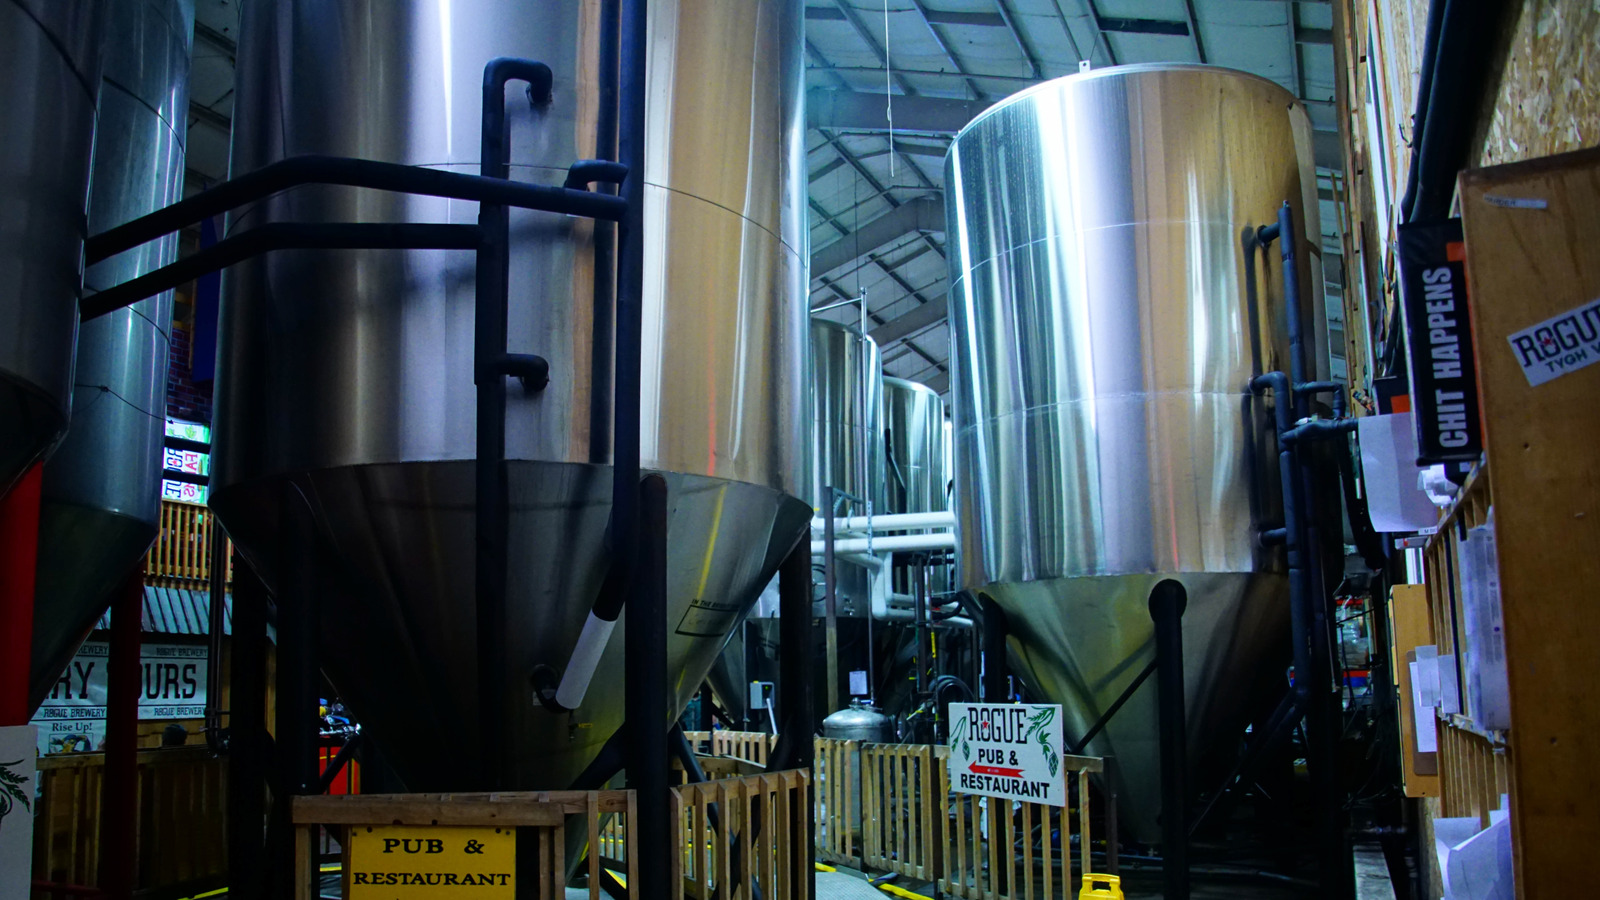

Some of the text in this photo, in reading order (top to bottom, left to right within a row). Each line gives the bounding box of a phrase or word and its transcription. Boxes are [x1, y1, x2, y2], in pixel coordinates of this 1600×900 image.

[1422, 266, 1468, 448] CHIT HAPPENS
[43, 707, 106, 718] ROGUE BREWERY
[154, 707, 175, 717] ROGUE
[52, 722, 93, 734] Rise Up!
[968, 707, 1028, 745] ROGUE
[978, 748, 1019, 766] PUB &
[960, 773, 1050, 799] RESTAURANT
[383, 838, 485, 854] PUB &
[353, 872, 511, 886] RESTAURANT
